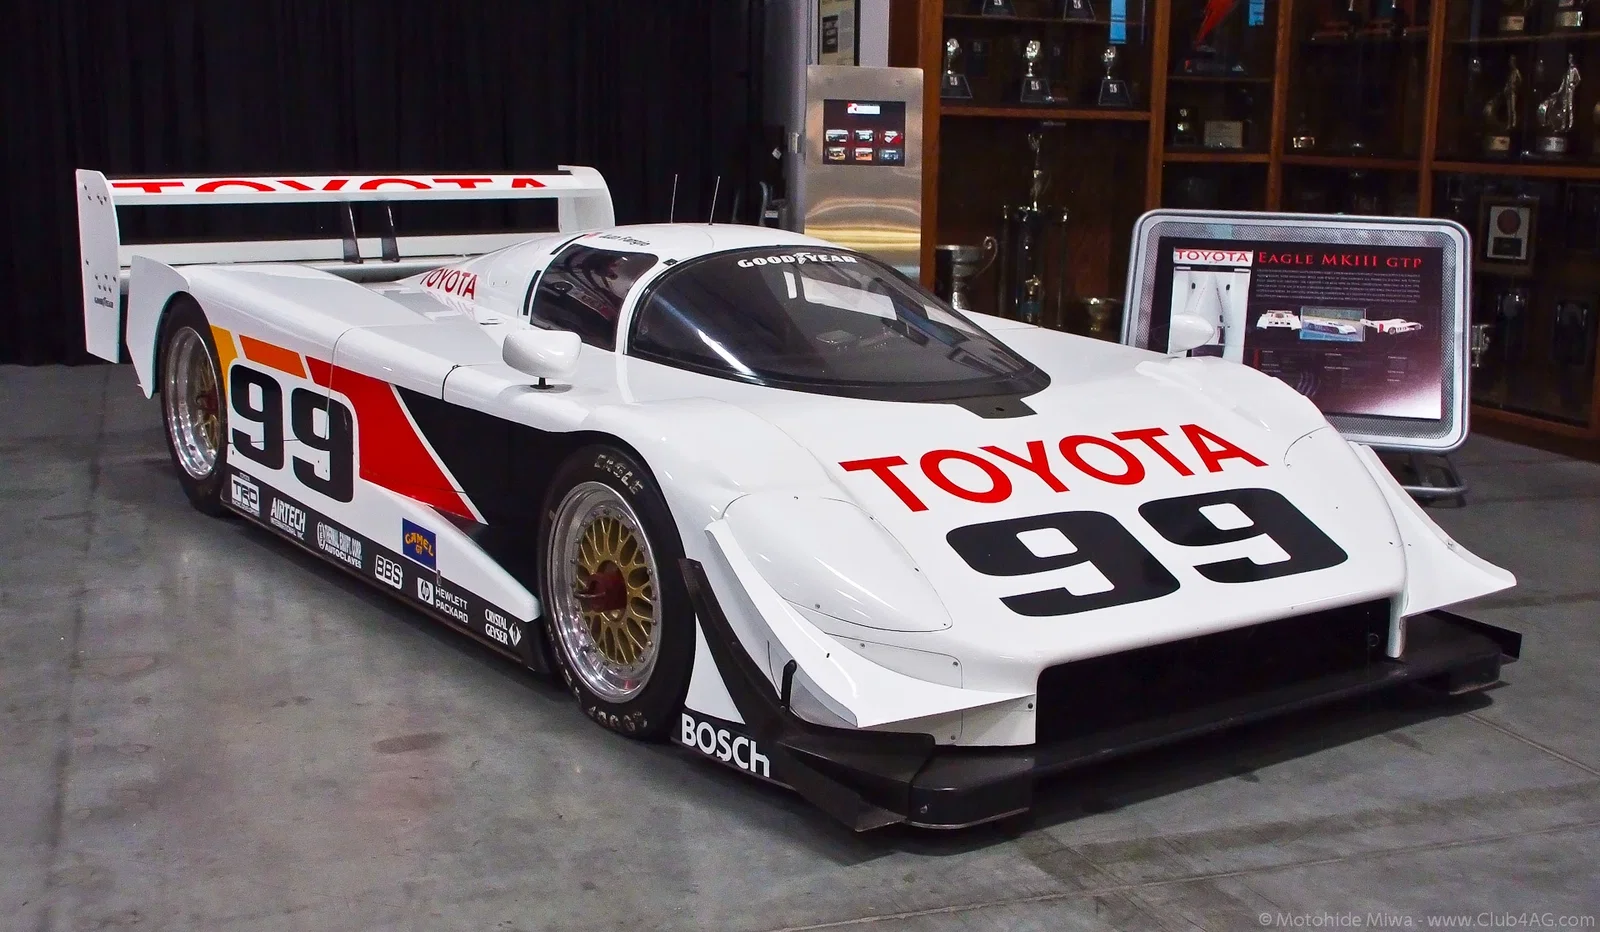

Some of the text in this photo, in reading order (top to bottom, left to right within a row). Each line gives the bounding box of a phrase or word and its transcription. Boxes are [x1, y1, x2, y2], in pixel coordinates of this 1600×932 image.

[737, 252, 858, 268] GOODYEAR
[1177, 250, 1249, 262] TOYOTA
[1321, 253, 1378, 267] MKIII
[1386, 257, 1423, 268] GTP
[420, 267, 477, 300] TOYOTA
[230, 364, 354, 503] 99
[838, 424, 1269, 512] TOYOTA
[233, 480, 258, 508] TRD
[271, 497, 306, 533] AIRTECH
[325, 544, 361, 569] AUTOCLAVES
[405, 532, 434, 557] CAMEL
[946, 487, 1349, 617] 99
[375, 554, 403, 589] BBS
[435, 586, 467, 610] HEWLETT
[435, 600, 469, 623] PACKARD
[485, 608, 508, 630] CRYSTAL
[485, 623, 508, 645] GEYSER
